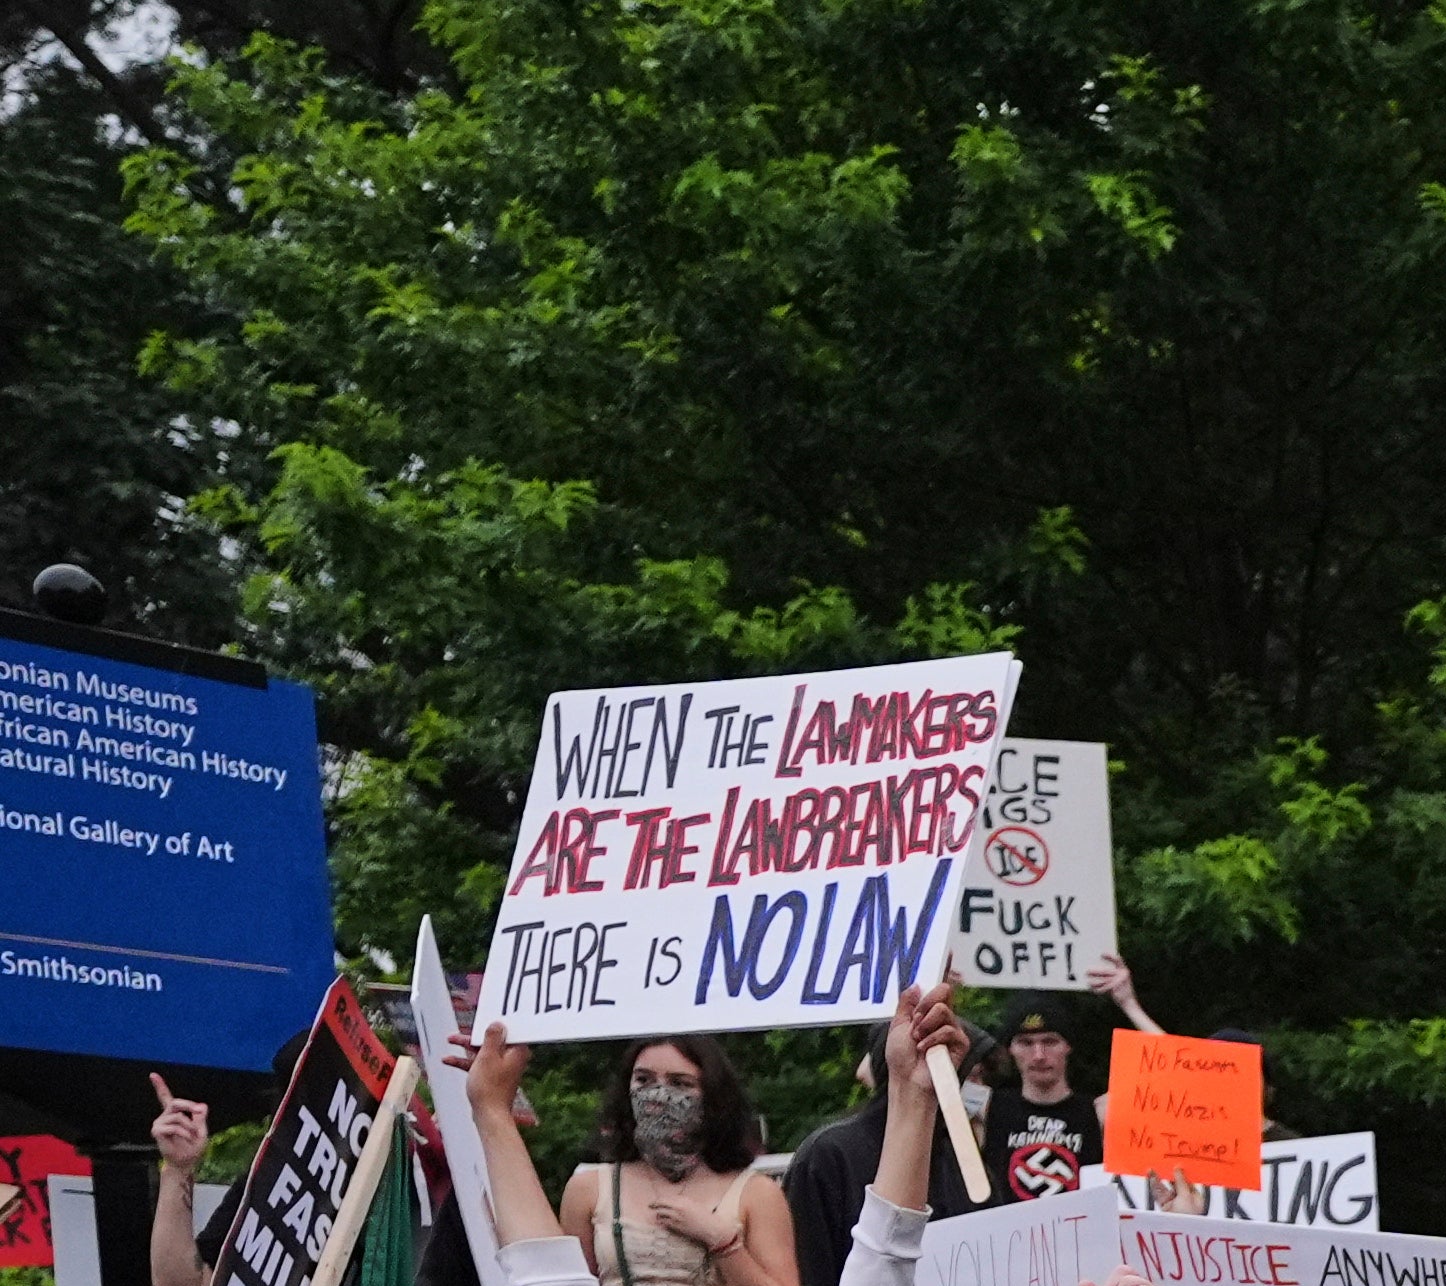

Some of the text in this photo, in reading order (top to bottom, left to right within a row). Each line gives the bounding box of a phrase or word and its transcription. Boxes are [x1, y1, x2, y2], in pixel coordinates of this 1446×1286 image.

[76, 671, 199, 716] Museums
[105, 705, 196, 747] History
[552, 684, 998, 801] WHEN THE LAWMAKERS
[76, 728, 197, 771] American
[201, 749, 287, 792] History
[82, 757, 173, 799] History
[69, 815, 235, 863] Gallery of Art
[508, 764, 989, 896] ARE THE LAWBREAKERS
[961, 887, 1079, 936] FUCK
[499, 858, 954, 1015] THERE IS NO LAW
[0, 950, 163, 993] Smithsonian
[975, 941, 1077, 982] OFF!
[1139, 1042, 1166, 1073] No
[1133, 1085, 1159, 1112] No
[1129, 1128, 1239, 1156] No Trump!
